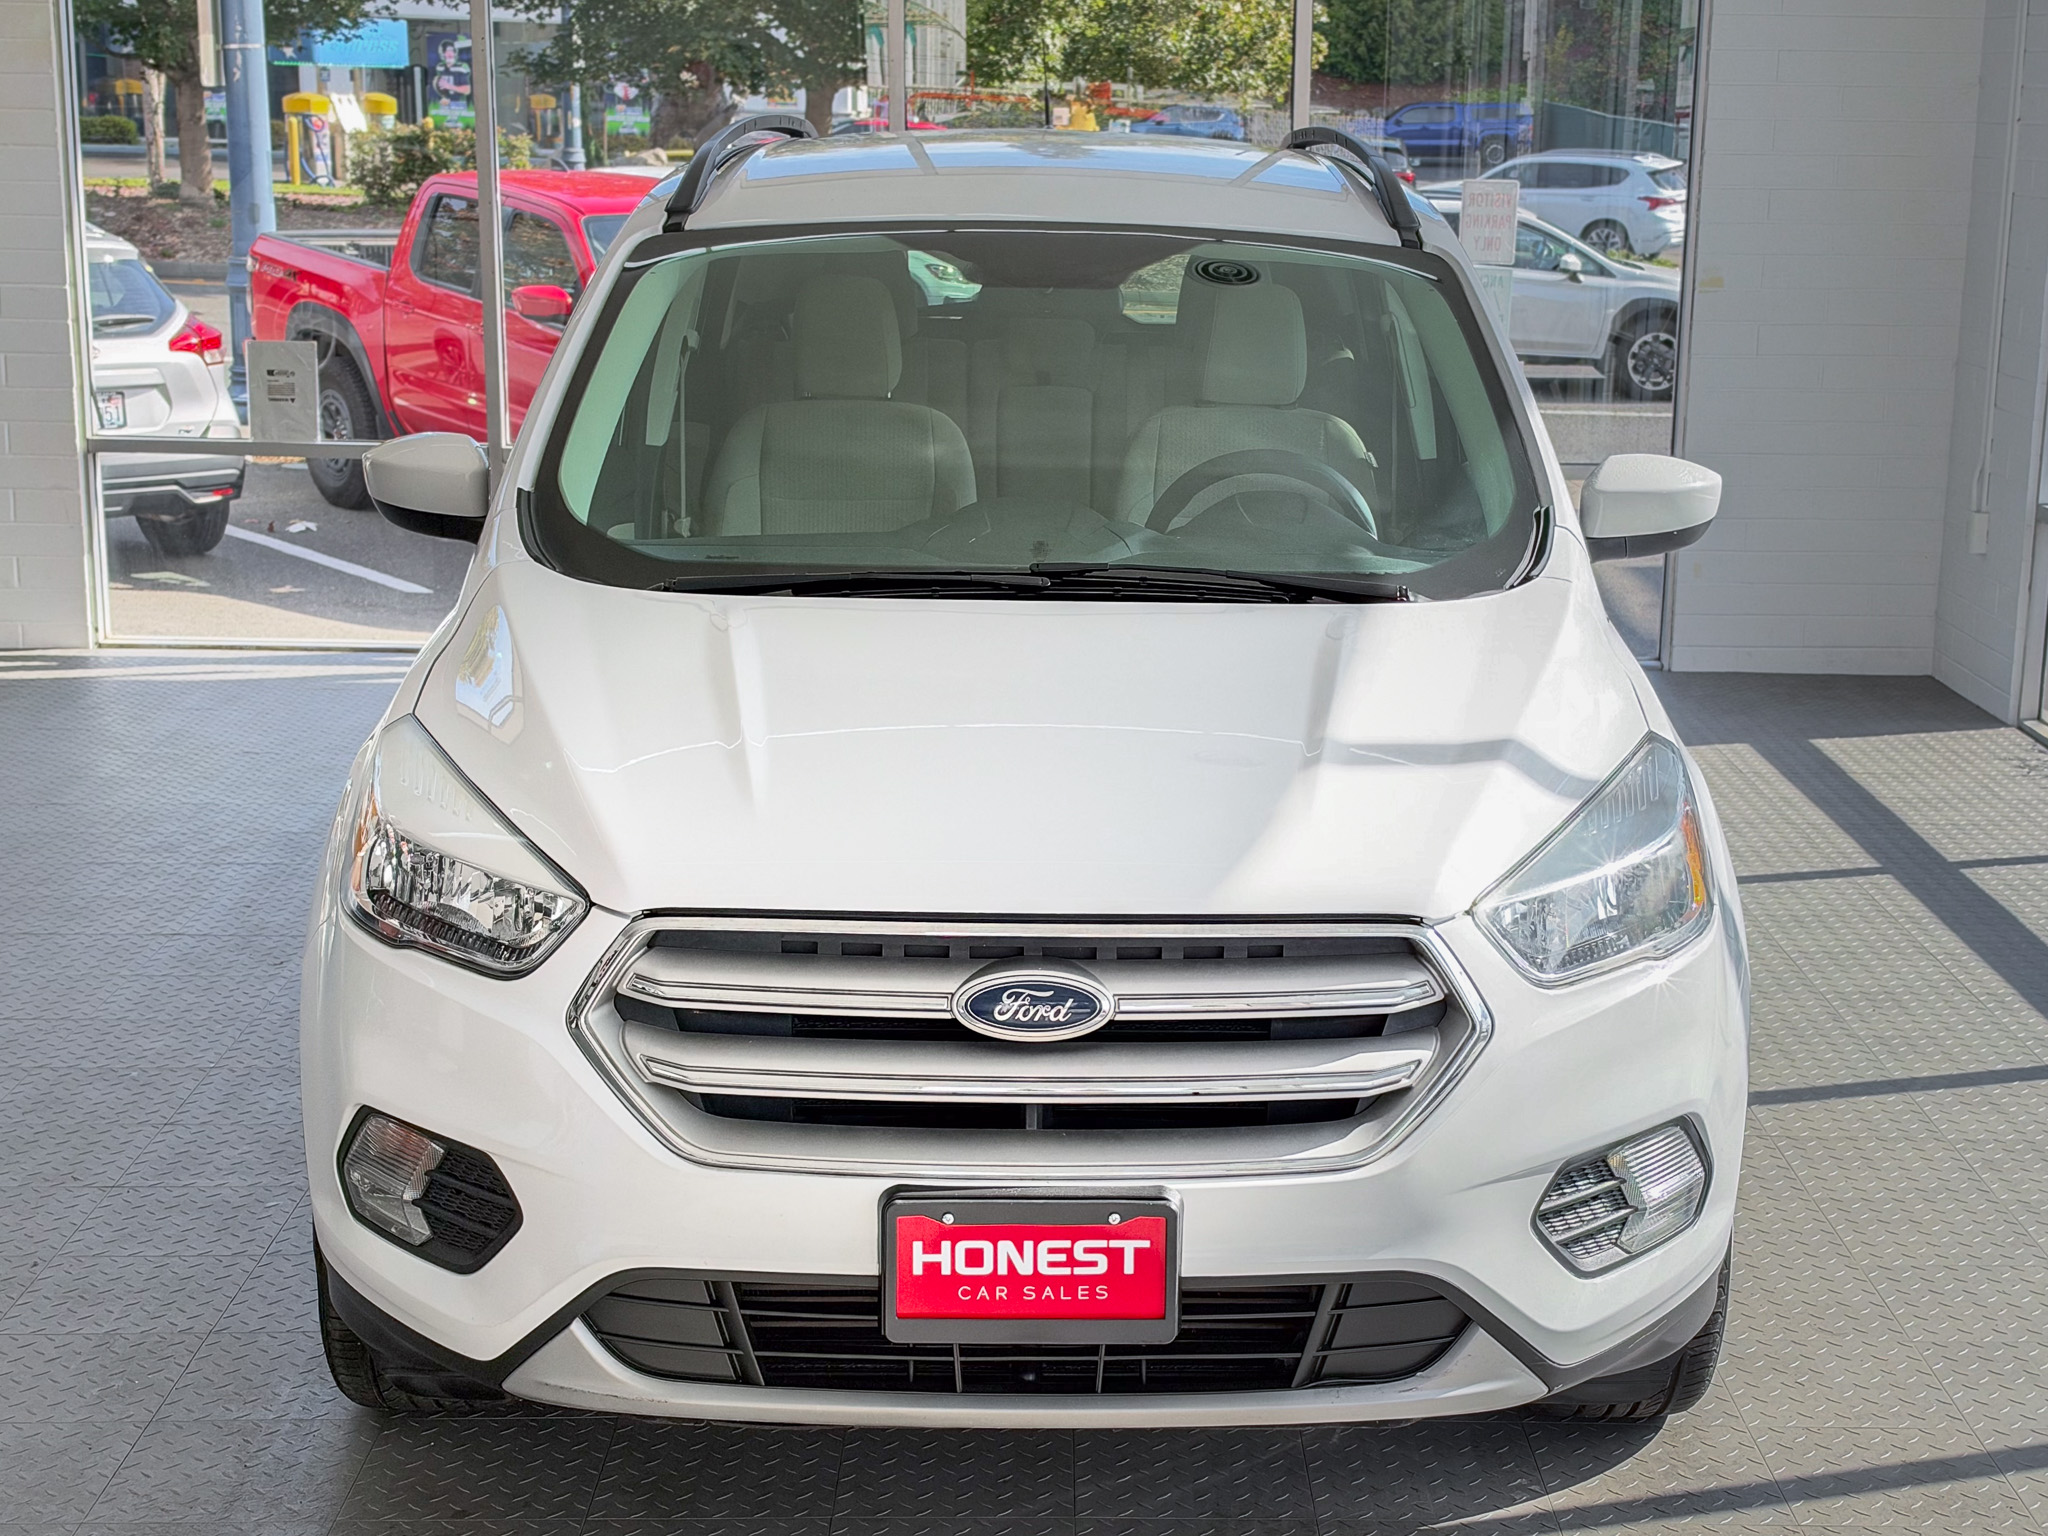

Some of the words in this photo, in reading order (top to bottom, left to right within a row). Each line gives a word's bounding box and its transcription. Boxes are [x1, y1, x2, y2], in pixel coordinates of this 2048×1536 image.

[100, 405, 121, 422] 51
[994, 988, 1075, 1022] Ford
[912, 1239, 1151, 1276] HONEST
[958, 1285, 1008, 1301] CAR
[1023, 1285, 1109, 1300] SALES
